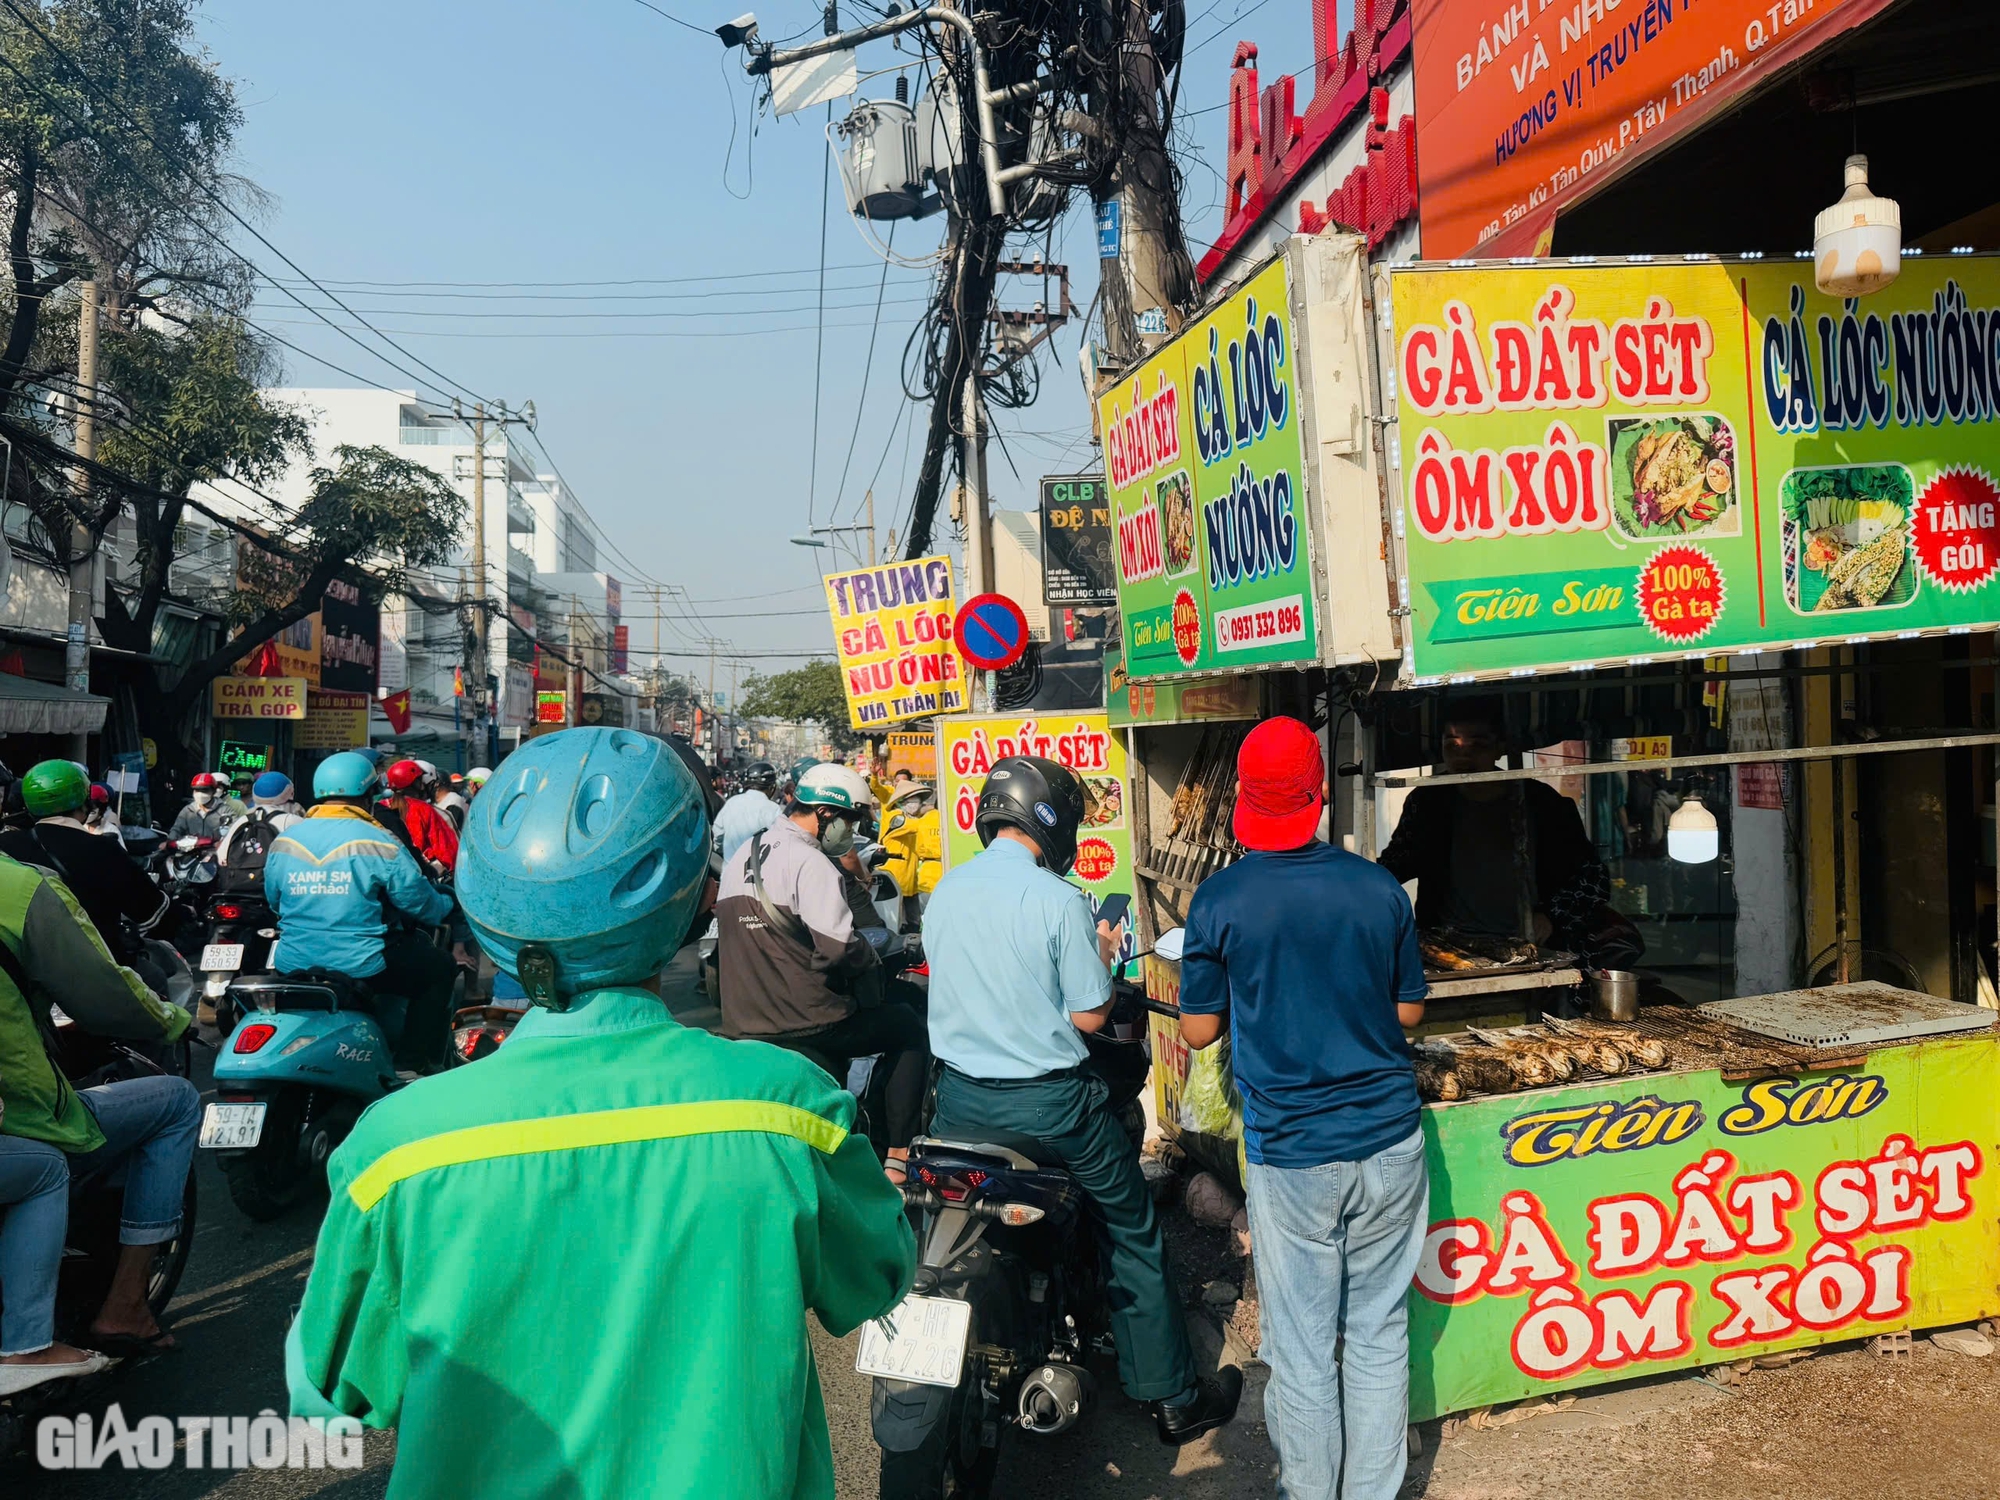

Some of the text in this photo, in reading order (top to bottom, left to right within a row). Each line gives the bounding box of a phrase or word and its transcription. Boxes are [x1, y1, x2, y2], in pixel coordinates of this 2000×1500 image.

[1456, 0, 1530, 93] BÁNH
[1510, 33, 1551, 95] VÀ
[1671, 45, 1740, 108] Thạnh,
[1494, 89, 1558, 167] HƯƠNG
[1562, 66, 1582, 109] VỊ
[1405, 288, 1704, 410] GÀ ĐẤT SÉT
[1762, 283, 1816, 429] CÁ
[1818, 296, 1888, 425] LÓC
[1193, 295, 1286, 464] CÁ LÓC
[1108, 373, 1180, 487] GÀ ĐẤT SÉT
[1051, 482, 1095, 503] CLB
[1413, 424, 1601, 537] ÔM XÔI
[1049, 504, 1086, 533] ĐỆ
[1117, 491, 1164, 579] ÔM XÔI
[1203, 460, 1295, 588] NƯỚNG
[1925, 500, 1996, 538] TẶNG
[1940, 535, 1985, 572] GỎI
[828, 560, 951, 617] TRUNG
[1049, 588, 1074, 600] NHẬN
[1076, 589, 1095, 599] HỌC
[1649, 563, 1711, 594] 100%
[1174, 602, 1196, 628] 100%
[1230, 604, 1302, 642] 0931 332 896
[1455, 580, 1626, 626] Tiên Sơn
[1651, 596, 1714, 621] Gà ta
[841, 608, 953, 658] CÁ LÓC
[1177, 629, 1202, 649] Gà ta
[271, 684, 295, 698] XE
[847, 650, 959, 697] NƯỚNG
[260, 701, 298, 716] GÓP
[856, 701, 889, 723] VÍA
[890, 689, 937, 716] THẦN
[952, 729, 991, 776] GÀ
[1057, 724, 1106, 769] SÉT
[1077, 844, 1111, 860] 100%
[1077, 859, 1113, 873] Gà ta
[287, 870, 352, 884] XANH SM
[290, 882, 349, 896] xin chào!
[335, 1041, 374, 1063] RACE
[1506, 1077, 1883, 1166] Tiên Sơn
[1417, 1138, 1976, 1296] GÀ ĐẤT SÉT
[1515, 1242, 1905, 1372] ÔM XÔI
